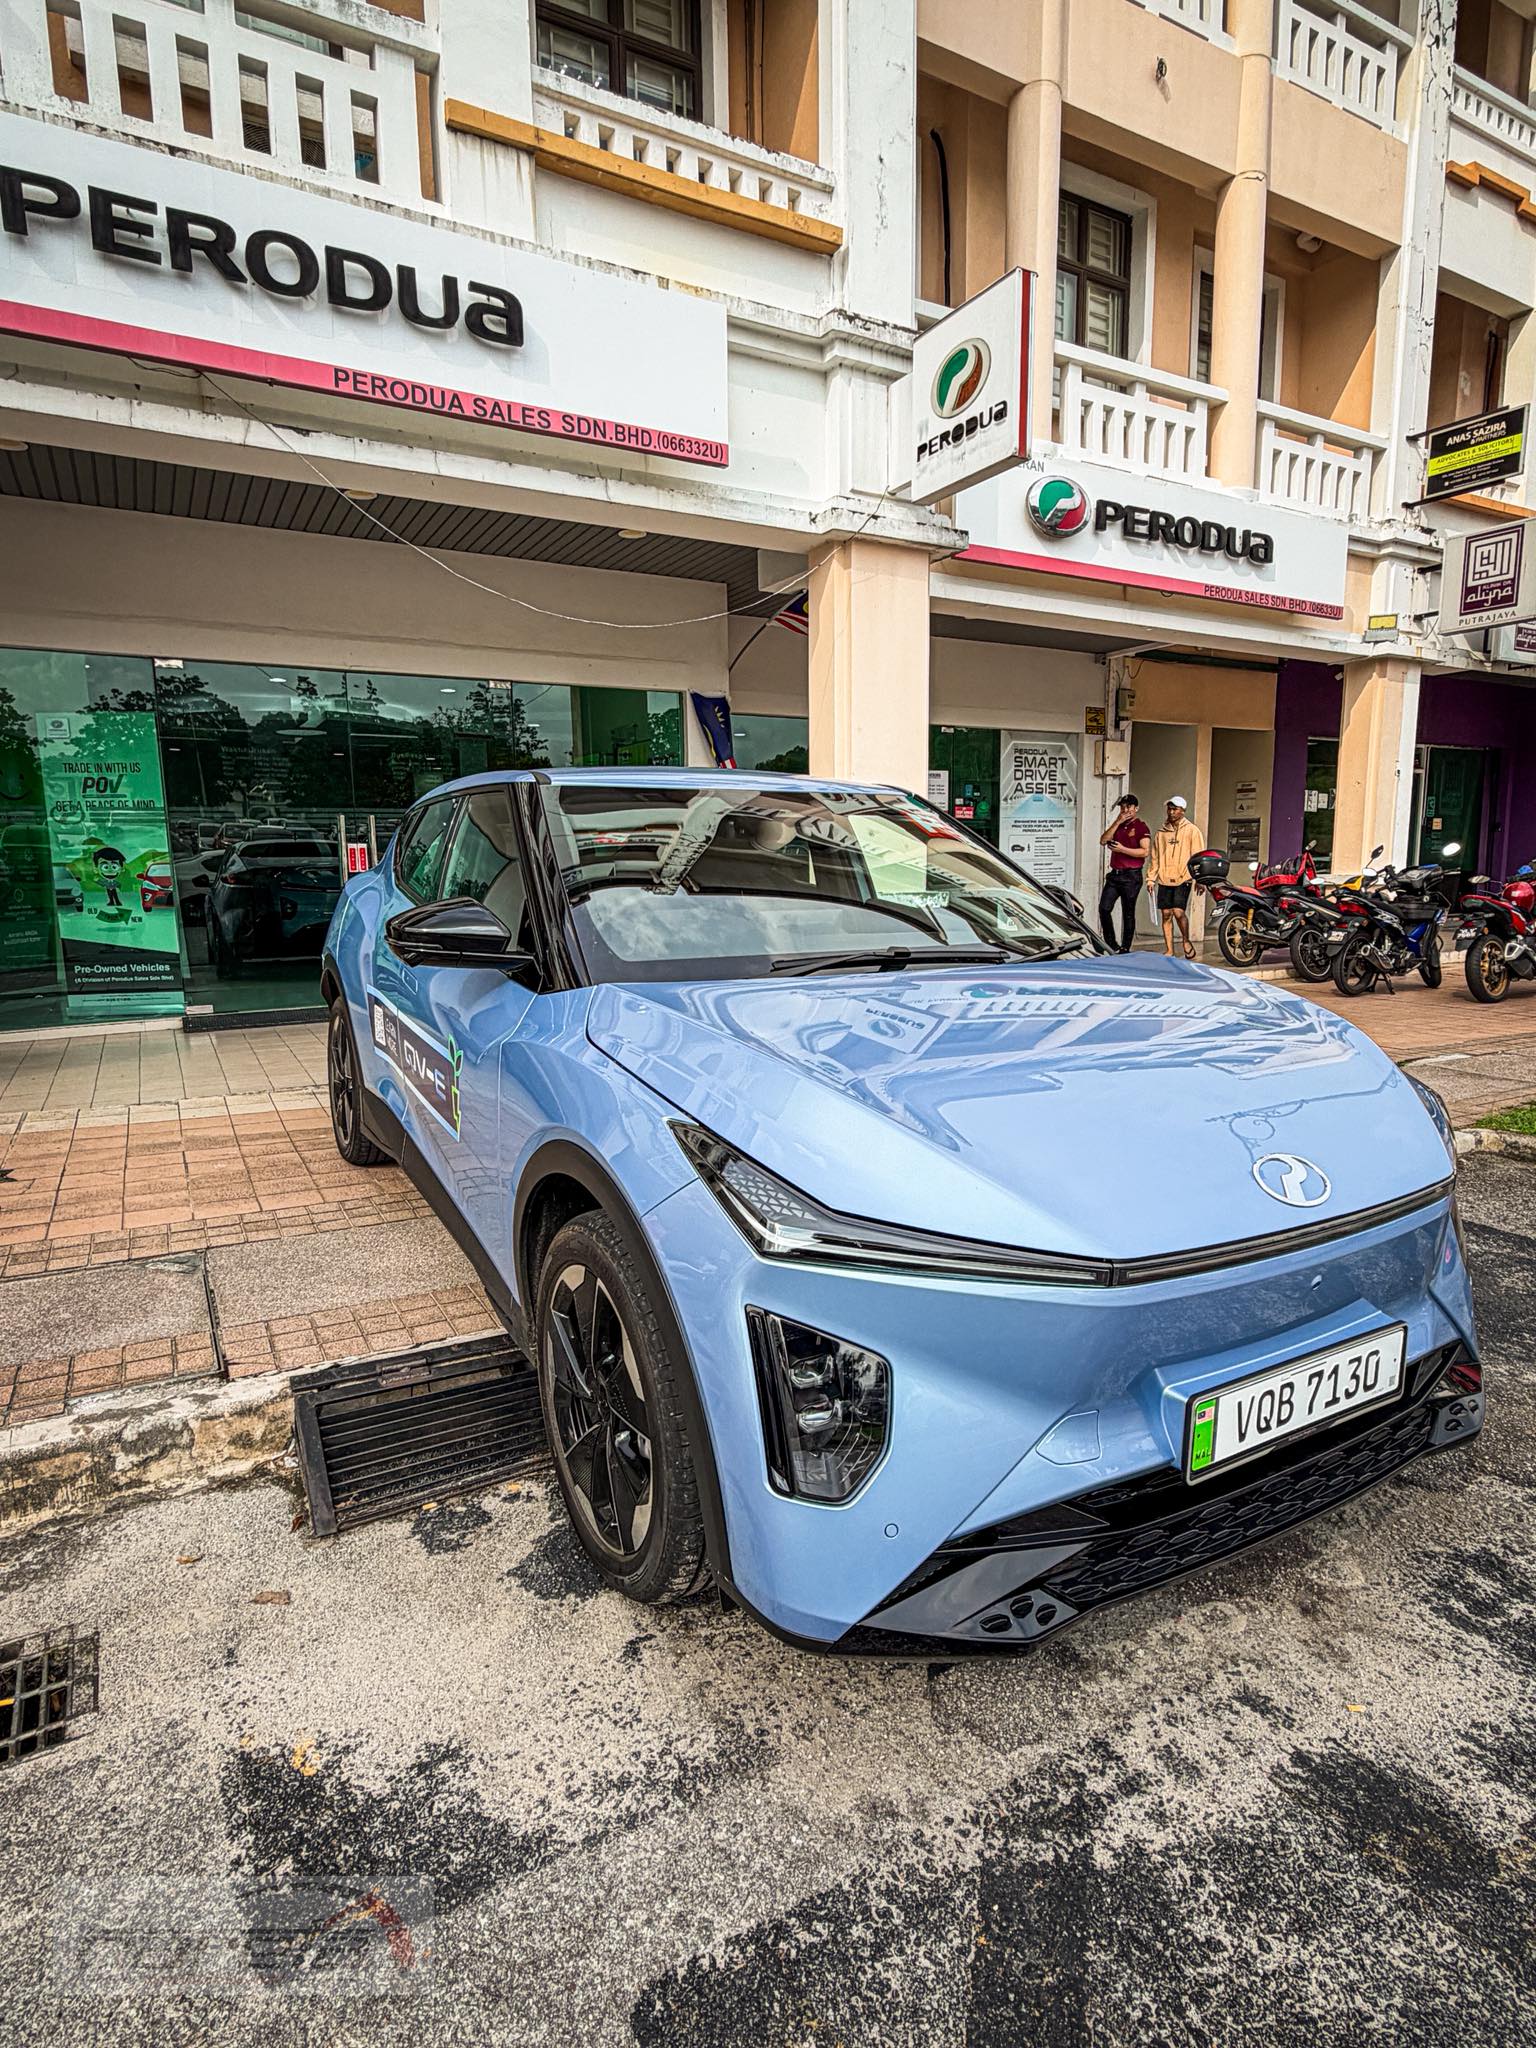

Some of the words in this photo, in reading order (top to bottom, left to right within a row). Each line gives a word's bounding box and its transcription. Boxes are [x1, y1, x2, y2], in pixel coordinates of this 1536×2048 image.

[333, 368, 465, 414] PERODUA
[472, 395, 551, 430] SALES
[1446, 432, 1471, 446] ANAS
[1472, 421, 1507, 439] SAZIRA
[1204, 585, 1243, 601] PERODUA
[1244, 591, 1270, 605] SALES
[1458, 610, 1517, 626] PUTRAJAYA
[1014, 748, 1049, 756] PERODUA
[63, 763, 94, 774] TRADE
[94, 763, 103, 774] IN
[104, 763, 127, 774] WITH
[129, 762, 141, 773] US
[1014, 756, 1068, 769] SMART
[1014, 769, 1058, 782] DRIVE
[82, 774, 127, 794] POV
[1013, 782, 1068, 795] ASSIST
[74, 963, 128, 974] Pre-Owned
[130, 962, 171, 973] Vehicles
[1237, 1380, 1296, 1444] VQB
[1307, 1350, 1381, 1416] 7130
[1195, 1450, 1212, 1461] MAL
